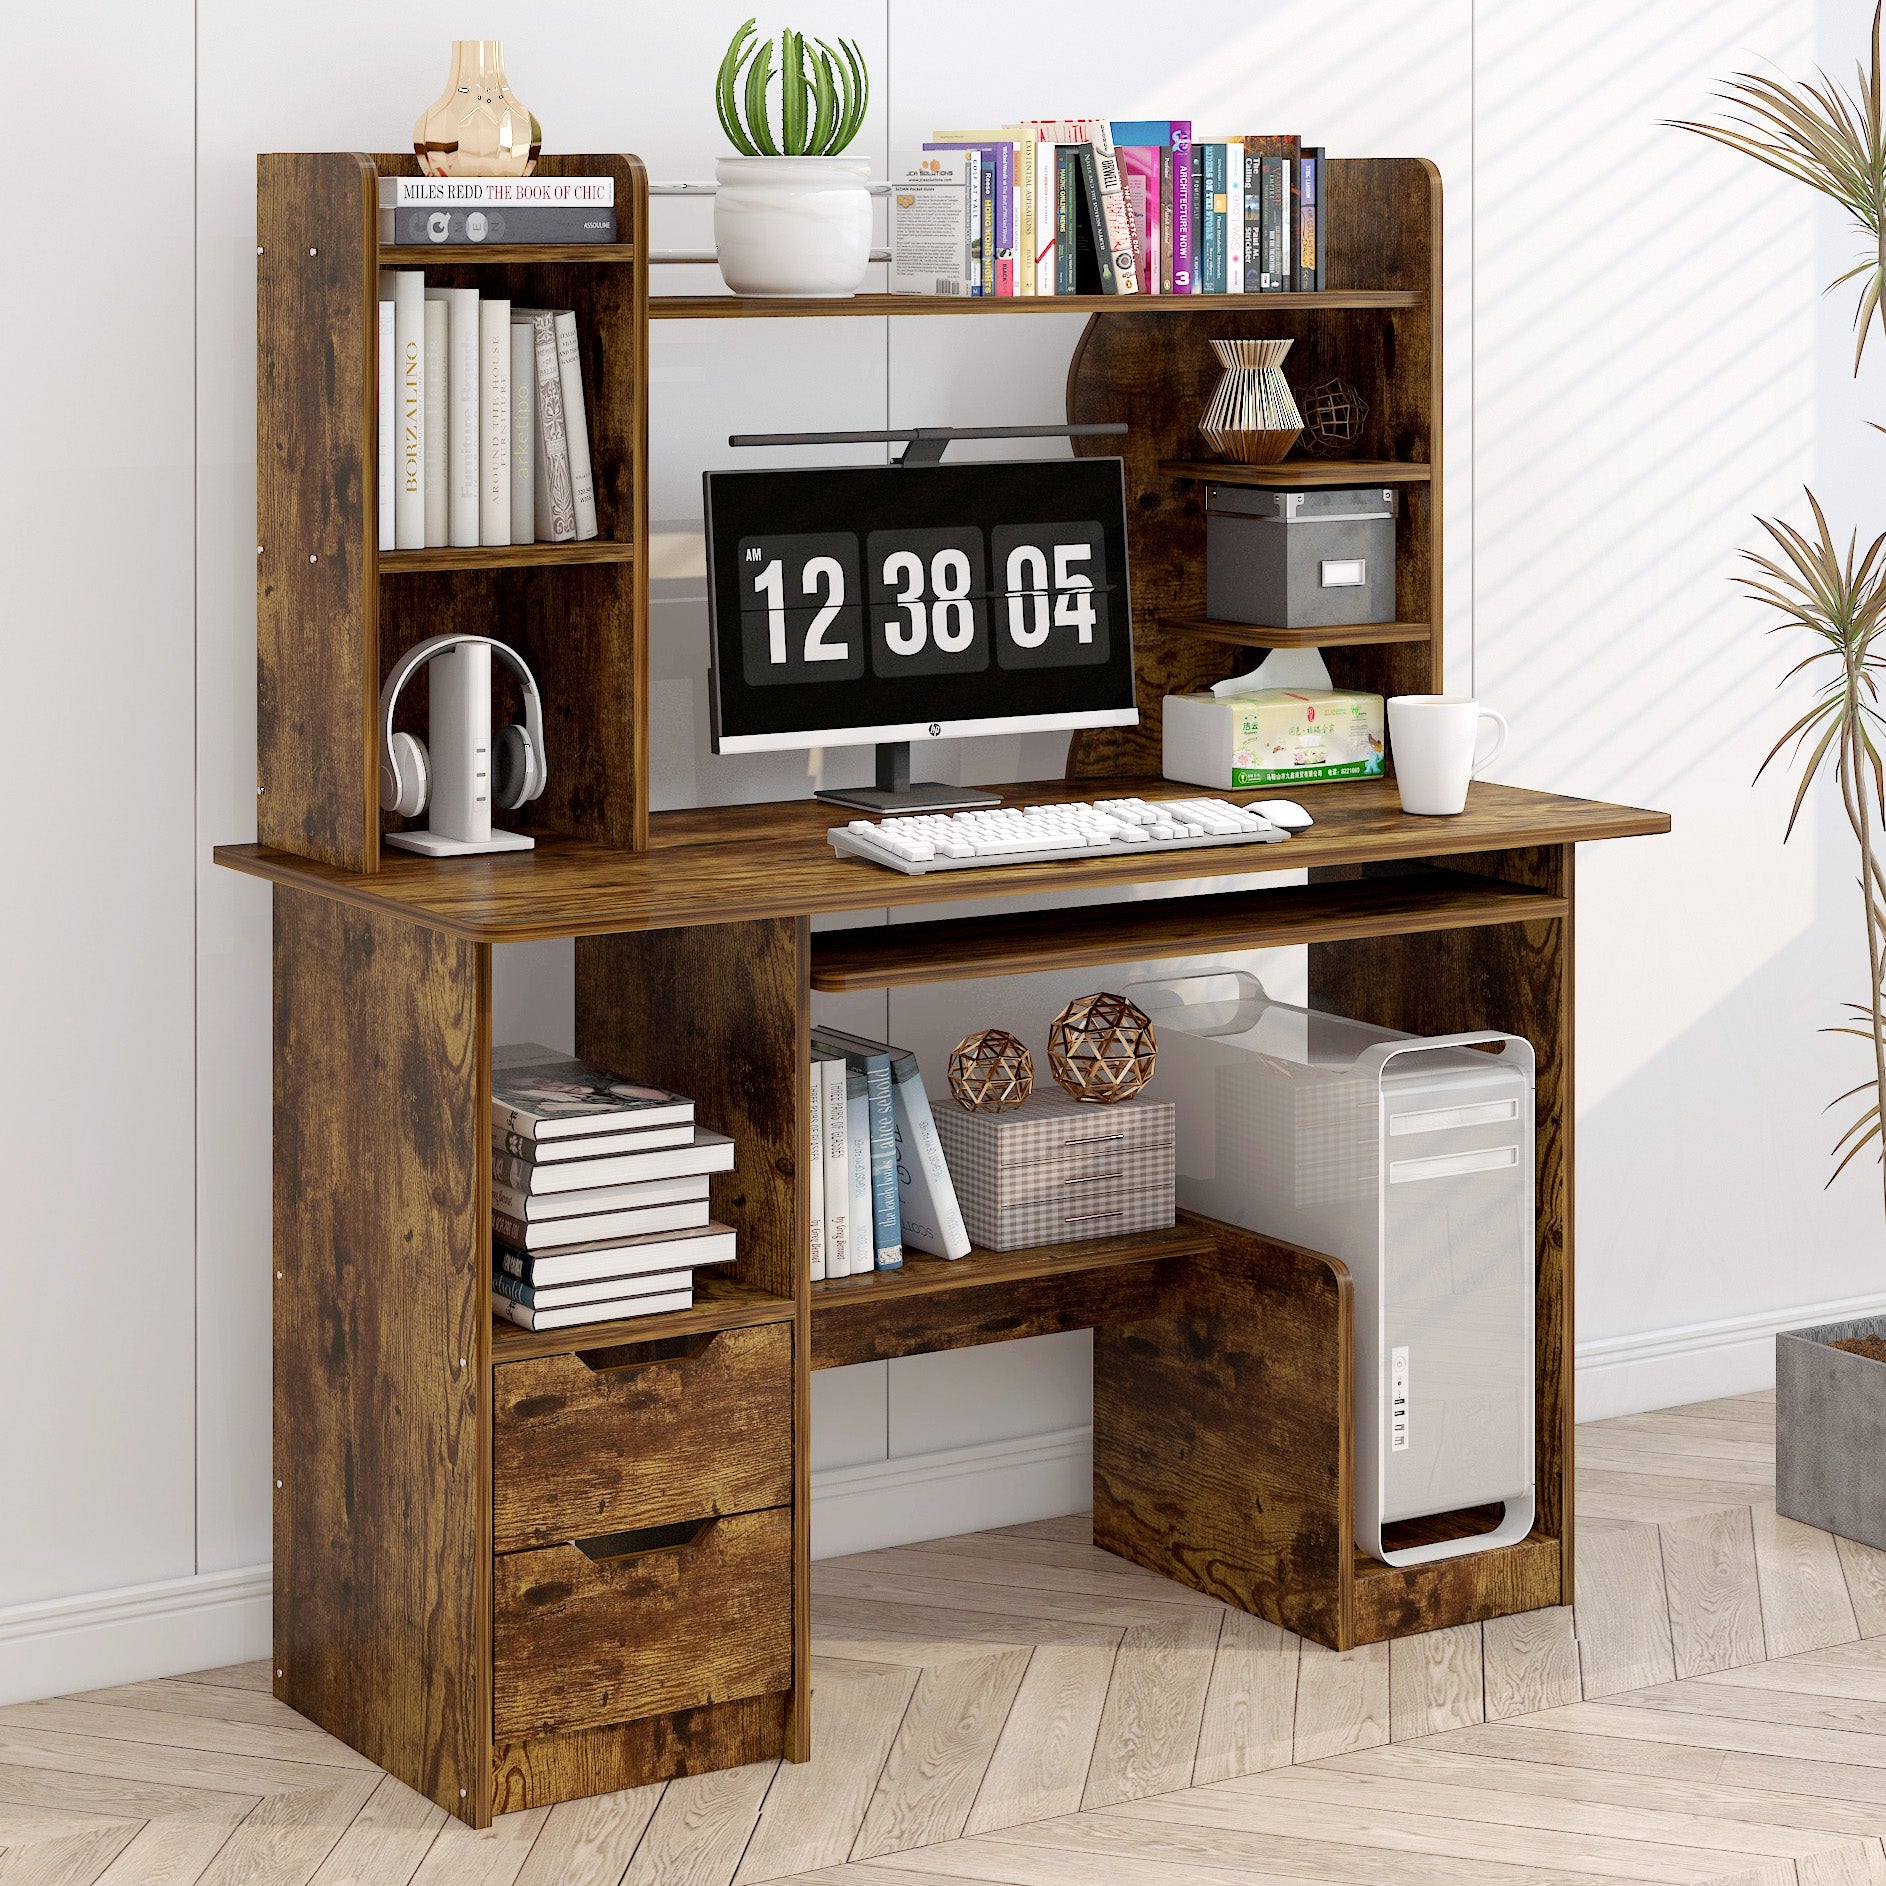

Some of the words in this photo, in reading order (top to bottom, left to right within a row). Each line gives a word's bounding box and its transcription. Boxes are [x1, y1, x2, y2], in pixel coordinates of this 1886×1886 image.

[1025, 140, 1033, 188] EXISTENTIAL
[1101, 160, 1117, 189] ORWELL
[1205, 146, 1214, 178] RIDERS
[1243, 158, 1253, 189] Calling
[1252, 157, 1260, 175] The
[404, 184, 444, 199] MILES
[448, 184, 483, 199] REDD
[486, 185, 512, 200] THE
[516, 185, 551, 200] BOOK
[554, 185, 571, 200] OF
[574, 185, 605, 200] CHIC
[972, 185, 978, 194] AT
[1123, 185, 1131, 201] THE
[1205, 179, 1214, 191] ON
[1179, 165, 1188, 233] ARCHITECTURE
[1205, 192, 1214, 211] THE
[1231, 195, 1240, 223] Love
[583, 221, 610, 229] ASSOULINE
[984, 199, 992, 227] HONG
[1025, 190, 1033, 236] ASPIRATIONS
[1059, 215, 1067, 233] NEWS
[1091, 202, 1101, 227] POTION
[1125, 202, 1137, 237] SECRETS
[1205, 211, 1214, 240] STORM
[984, 229, 992, 256] KONG
[1131, 239, 1140, 255] OUT
[1179, 234, 1188, 259] NOW!
[1244, 226, 1253, 264] Strickler
[1252, 226, 1260, 246] Paul
[1252, 247, 1260, 260] M.
[984, 258, 992, 294] NIGHTS
[1175, 270, 1191, 286] 3
[491, 335, 500, 387] HOUSE
[405, 341, 418, 494] BORZALINO
[491, 395, 500, 428] THE
[513, 384, 531, 479] arketipo
[491, 436, 500, 505] AROUND
[745, 548, 762, 562] AM
[753, 556, 850, 665] 12
[882, 548, 975, 656] 38
[810, 1085, 819, 1104] THREE
[830, 1081, 843, 1102] THREE
[866, 1067, 892, 1113] sebold
[830, 1102, 843, 1120] PAIRS
[831, 1121, 844, 1130] OF
[871, 1116, 896, 1149] alice
[918, 1119, 933, 1140] FATHER
[831, 1131, 845, 1159] GLASSES
[876, 1160, 895, 1186] bones
[928, 1155, 942, 1172] GHOST
[877, 1186, 897, 1212] lovely
[832, 1216, 846, 1224] by
[878, 1211, 896, 1227] the
[831, 1225, 846, 1239] Greg
